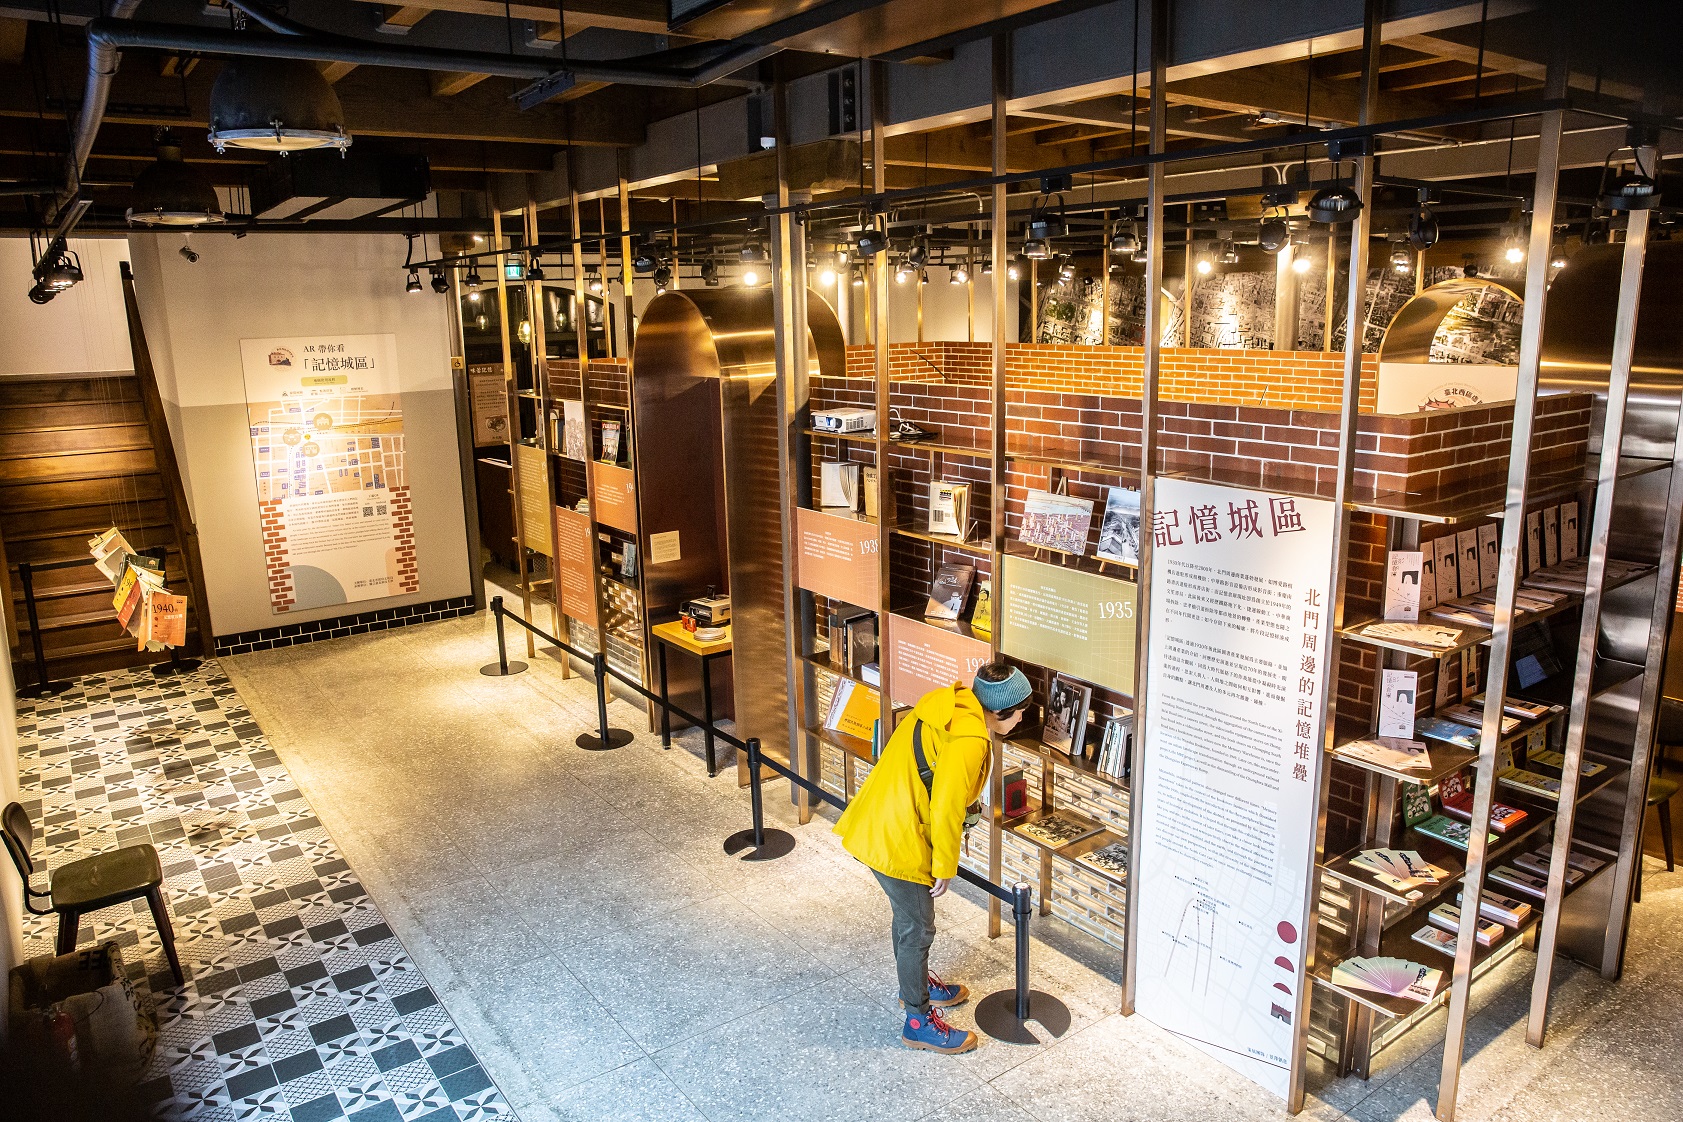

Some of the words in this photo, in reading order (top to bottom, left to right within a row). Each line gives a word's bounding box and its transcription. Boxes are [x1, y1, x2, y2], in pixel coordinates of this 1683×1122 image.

[303, 345, 316, 353] AR
[317, 343, 346, 354] 帶你看
[1152, 496, 1307, 549] 記憶城區
[1097, 601, 1133, 619] 1935
